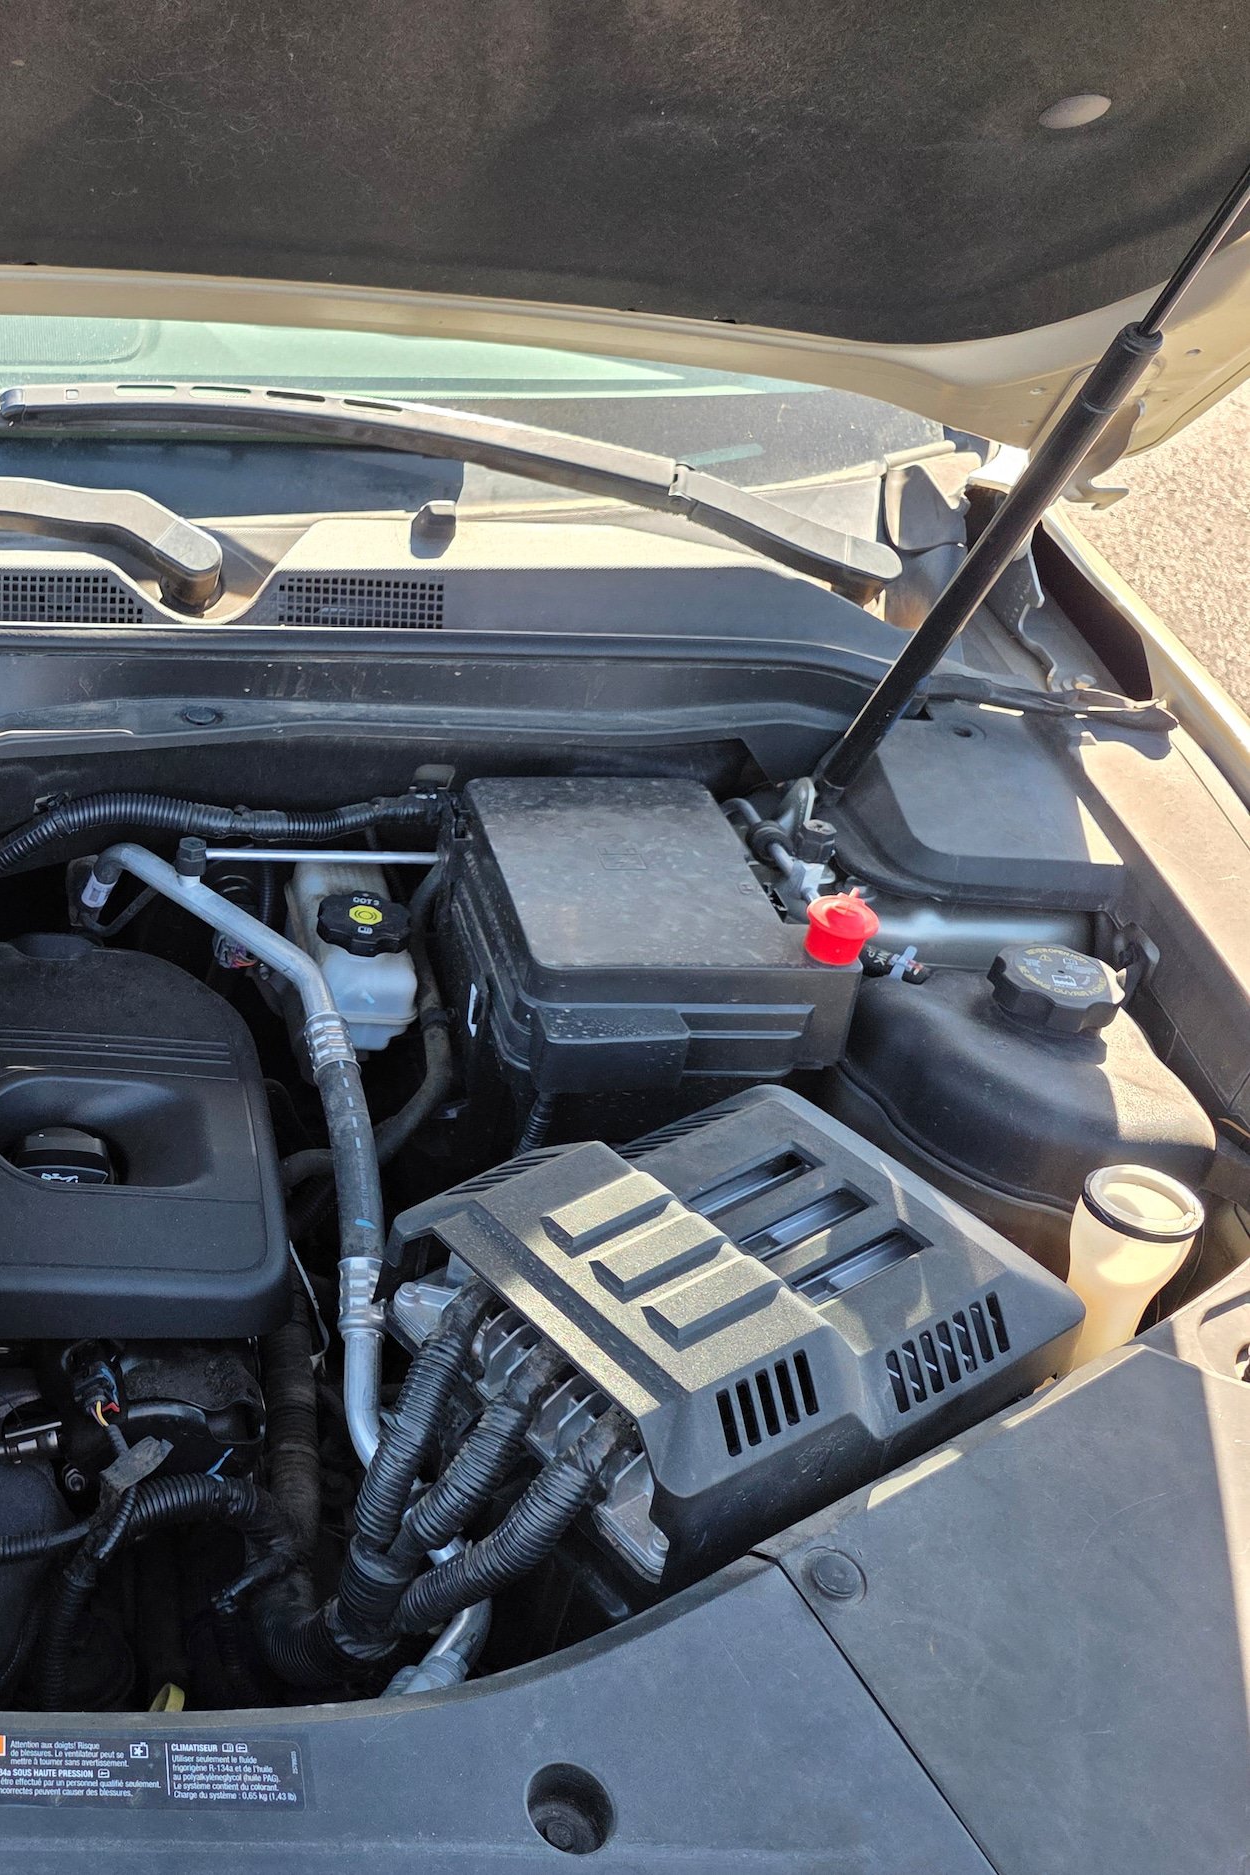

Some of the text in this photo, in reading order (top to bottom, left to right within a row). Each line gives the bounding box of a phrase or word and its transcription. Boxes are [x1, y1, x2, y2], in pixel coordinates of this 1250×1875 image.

[10, 1740, 39, 1748] Attention
[54, 1741, 76, 1750] doigts!
[77, 1742, 99, 1751] Risque
[171, 1744, 218, 1752] CLIMATISEUR
[99, 1751, 114, 1760] peut
[39, 1758, 62, 1766] tourner
[81, 1759, 129, 1767] avertissement.
[12, 1769, 32, 1777] SOUS
[33, 1769, 56, 1777] HAUTE
[58, 1769, 93, 1778] PRESSION
[15, 1778, 41, 1786] effectué
[43, 1780, 54, 1788] par
[66, 1779, 98, 1788] personnel
[99, 1780, 123, 1789] qualifié
[124, 1780, 161, 1788] seulement.
[183, 1783, 210, 1791] système
[34, 1788, 60, 1796] peuvent
[174, 1791, 197, 1800] Charge
[198, 1791, 207, 1799] du
[209, 1791, 236, 1801] système
[258, 1792, 267, 1801] kg
